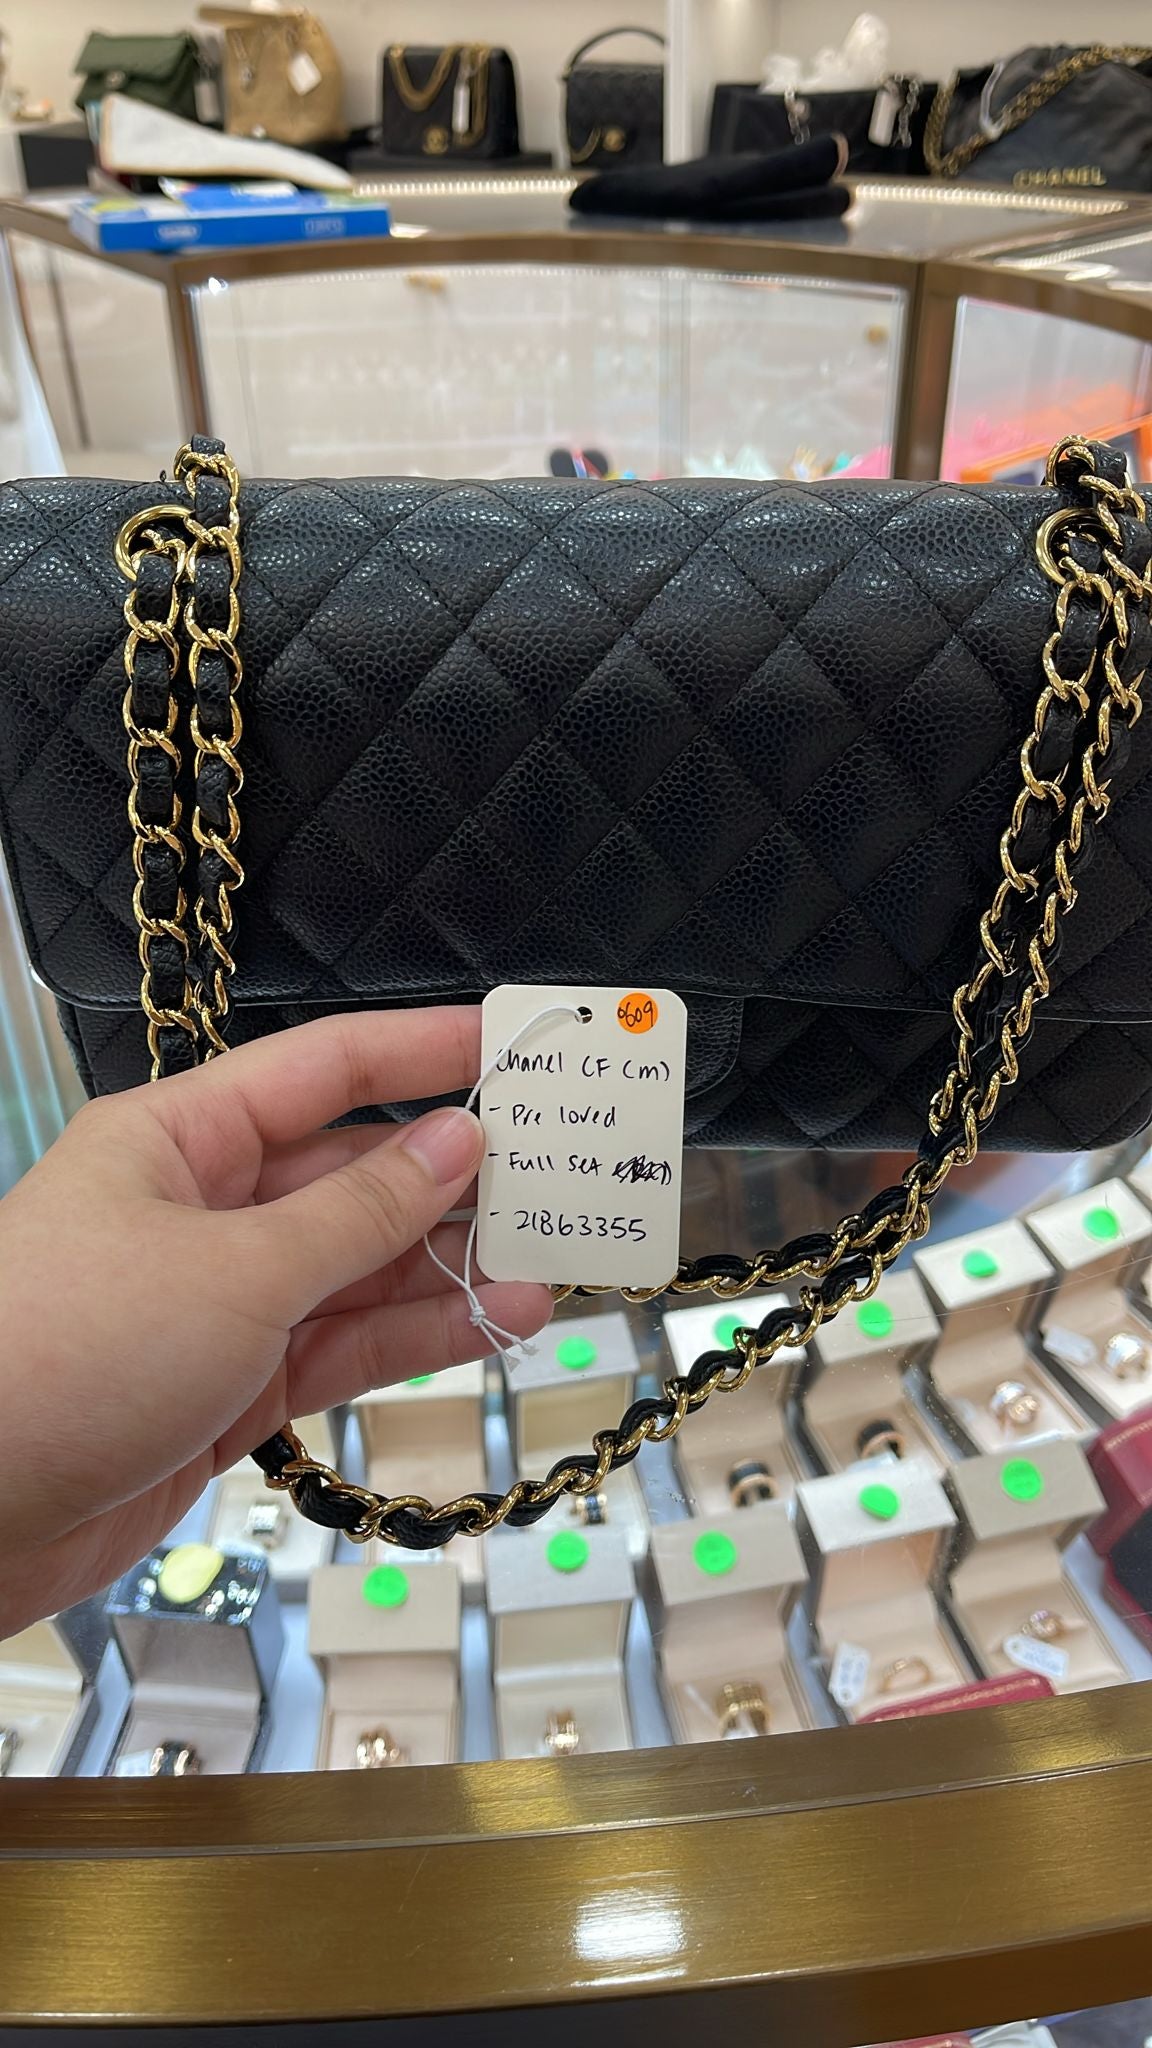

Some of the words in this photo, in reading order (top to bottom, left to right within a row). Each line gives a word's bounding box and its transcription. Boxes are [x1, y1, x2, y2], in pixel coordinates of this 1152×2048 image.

[1013, 165, 1107, 189] CHANEL
[512, 1103, 542, 1127] Pre
[559, 1105, 616, 1128] loved
[509, 1151, 555, 1172] Full
[513, 1209, 648, 1243] 21863355
